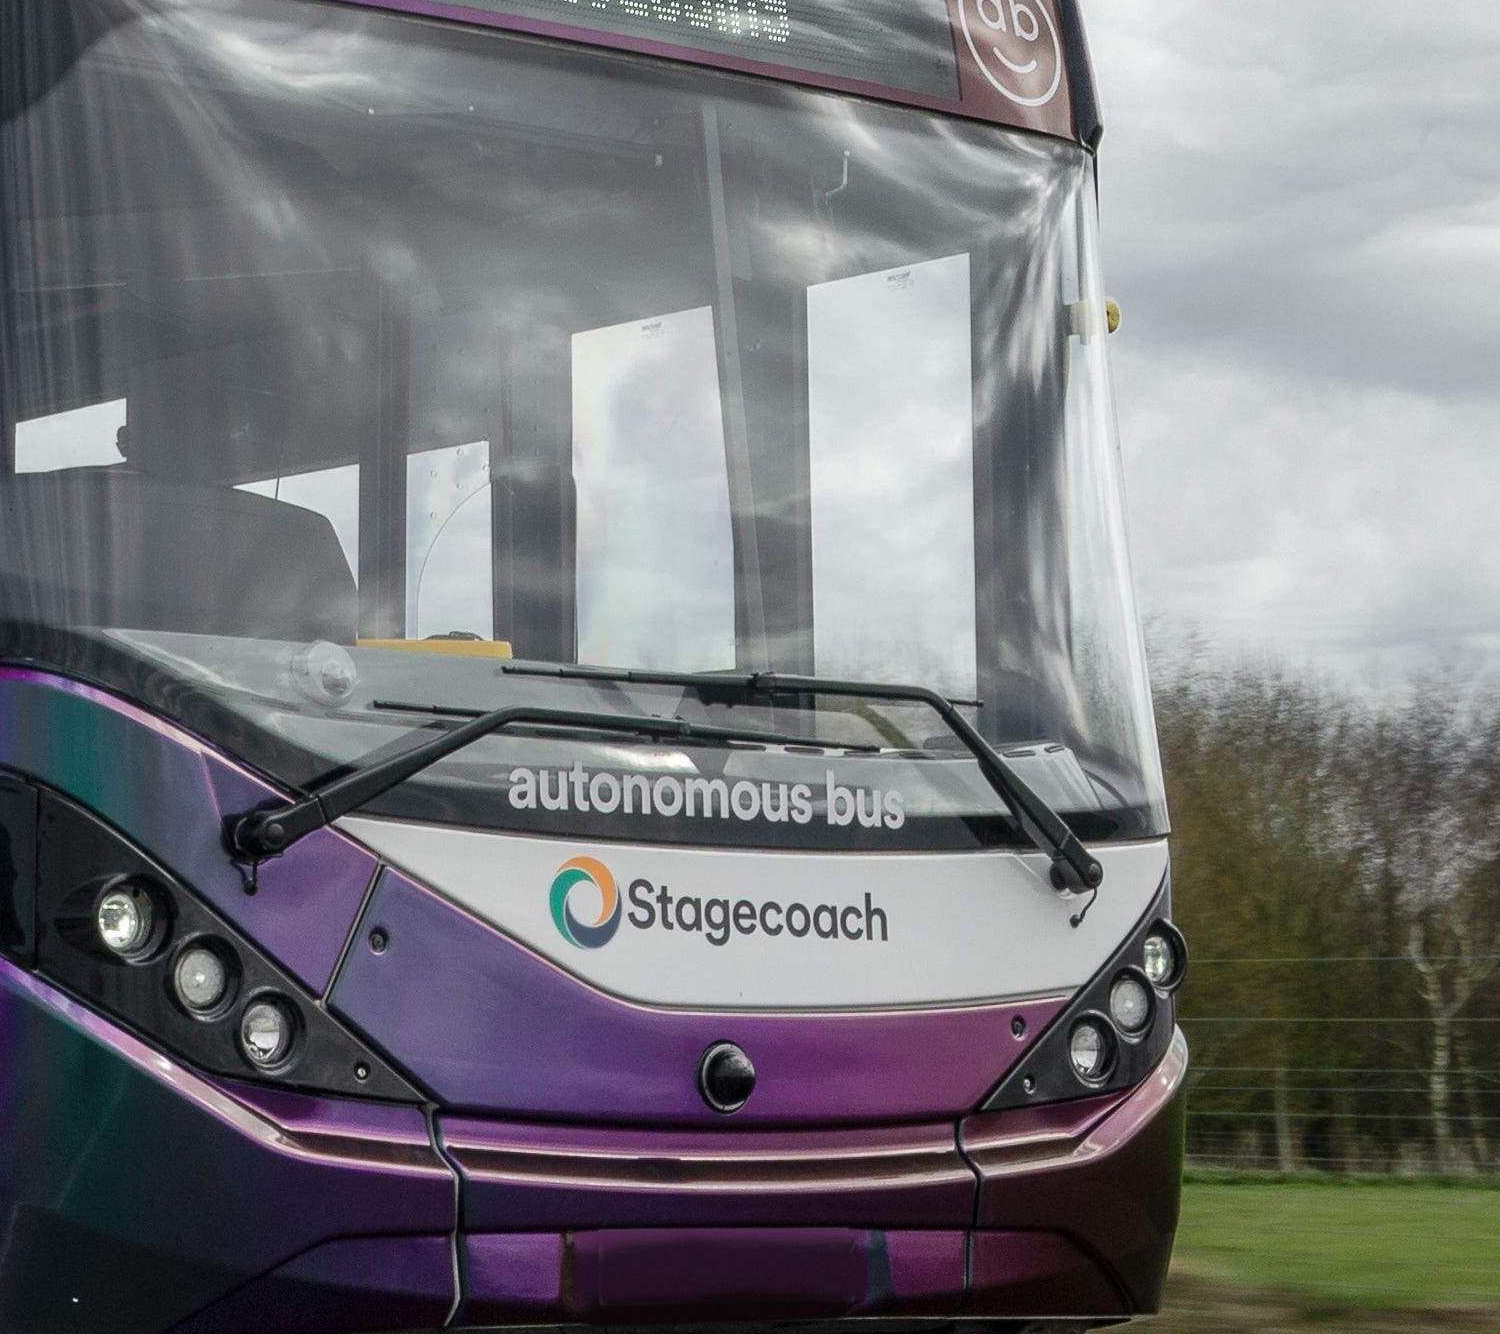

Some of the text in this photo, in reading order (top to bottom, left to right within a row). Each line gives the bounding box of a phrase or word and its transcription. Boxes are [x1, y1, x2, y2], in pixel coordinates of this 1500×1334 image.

[507, 761, 906, 830] autonomous bus
[627, 878, 889, 947] Stagecoach
